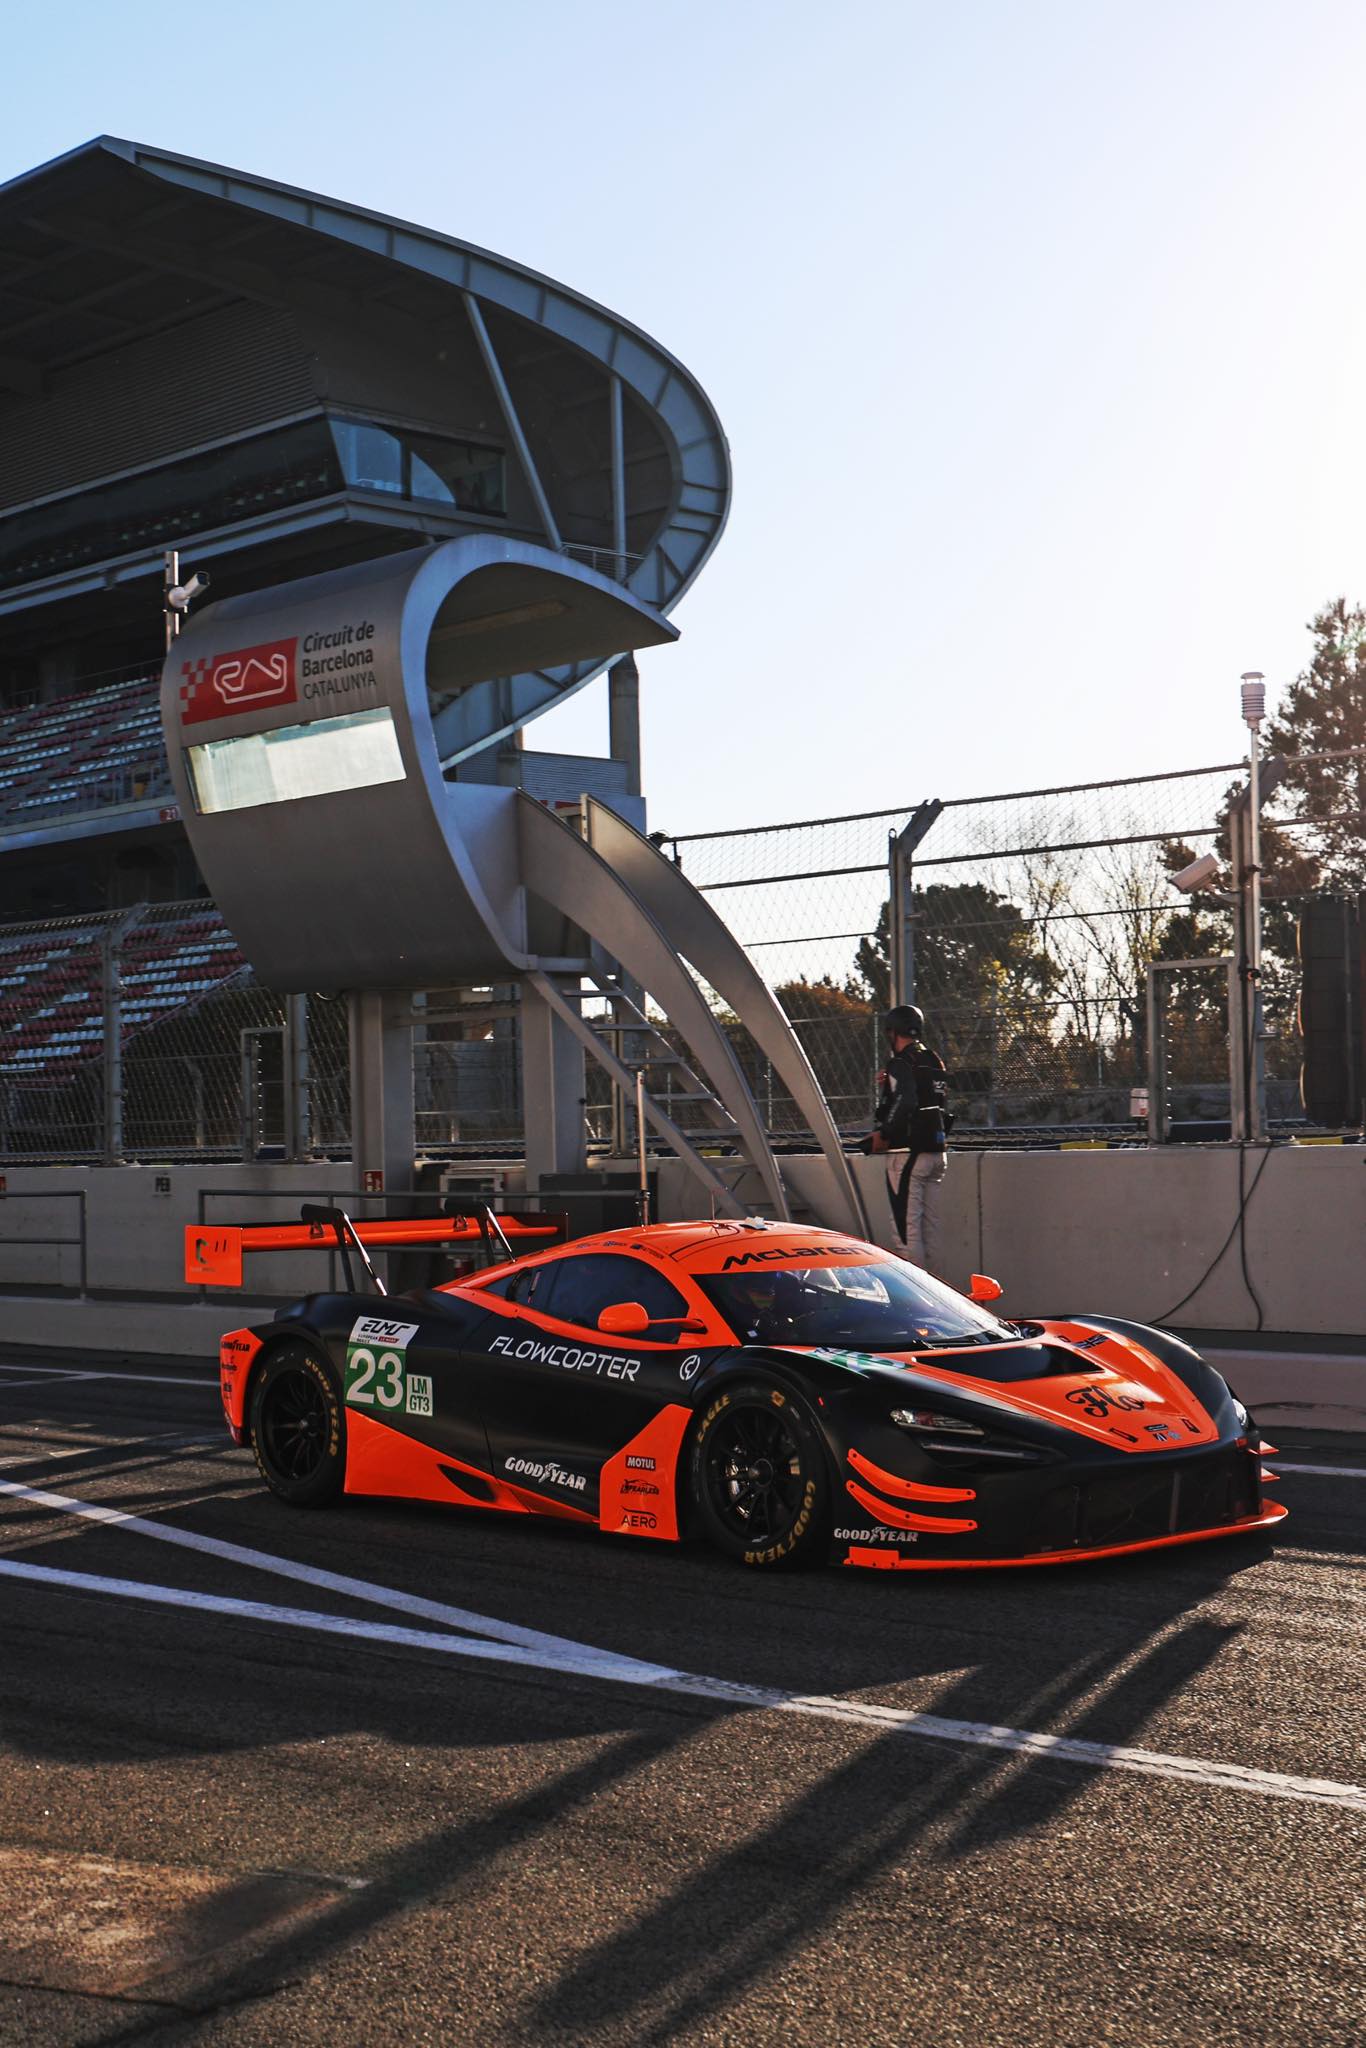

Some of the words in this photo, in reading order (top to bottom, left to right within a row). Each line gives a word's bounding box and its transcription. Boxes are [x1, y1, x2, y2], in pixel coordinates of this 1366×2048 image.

[303, 624, 354, 653] Circuit
[356, 621, 375, 641] de
[302, 648, 373, 677] Barcelona
[303, 670, 377, 700] CATALUNYA
[721, 1246, 872, 1271] McLaren
[488, 1336, 640, 1382] FLOWCOPTER
[347, 1348, 404, 1408] 23
[411, 1376, 427, 1395] LM
[409, 1394, 430, 1413] GT3
[627, 1456, 656, 1470] MOTUL
[621, 1514, 658, 1529] AERO
